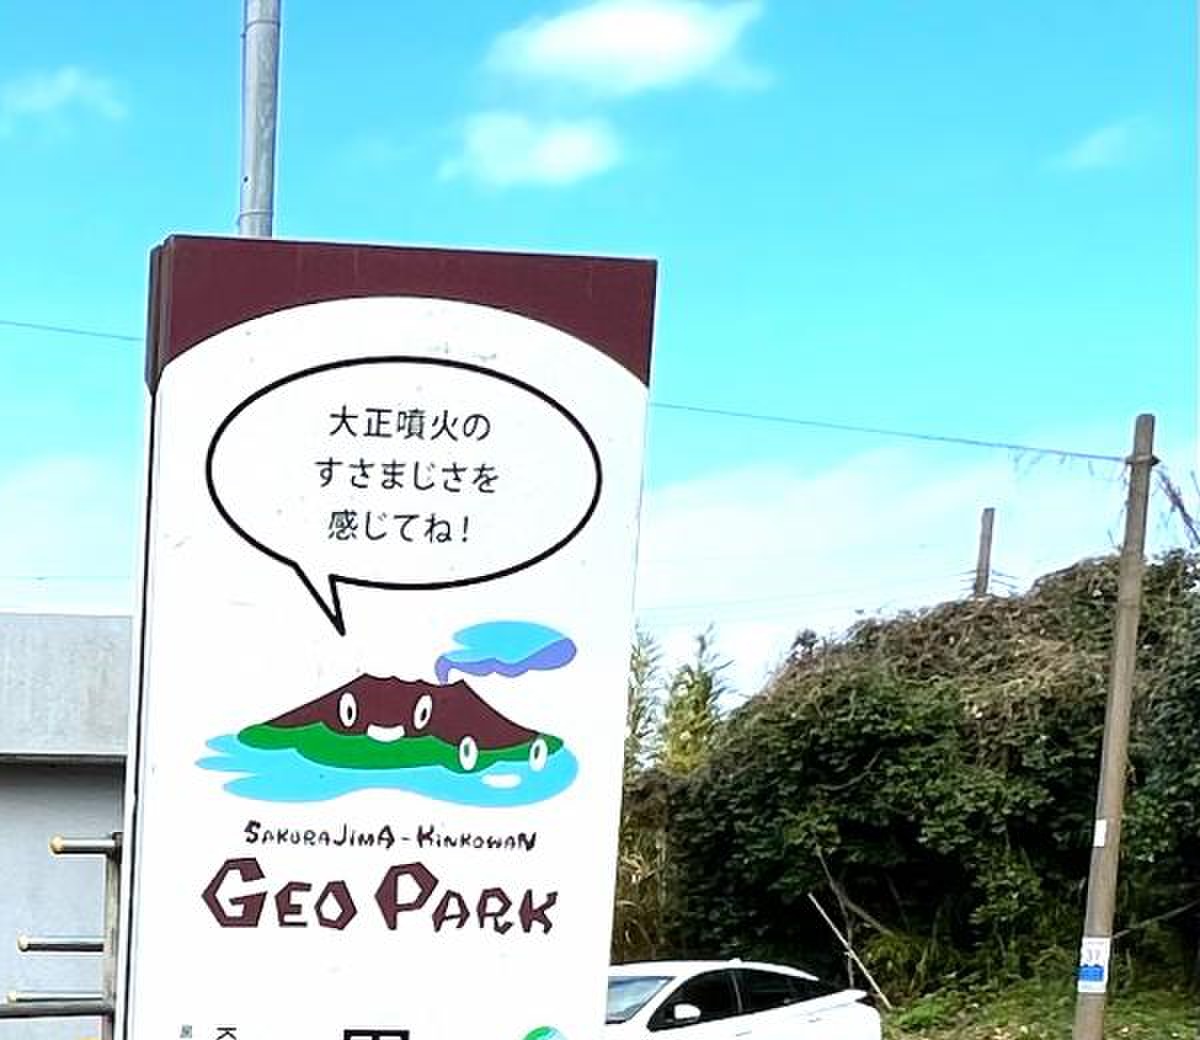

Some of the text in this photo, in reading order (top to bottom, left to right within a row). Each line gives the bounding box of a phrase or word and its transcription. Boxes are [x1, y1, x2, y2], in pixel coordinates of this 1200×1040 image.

[328, 405, 491, 442] 大正噴火の
[314, 456, 499, 494] すさまじさを
[201, 857, 558, 935] GEO PARK
